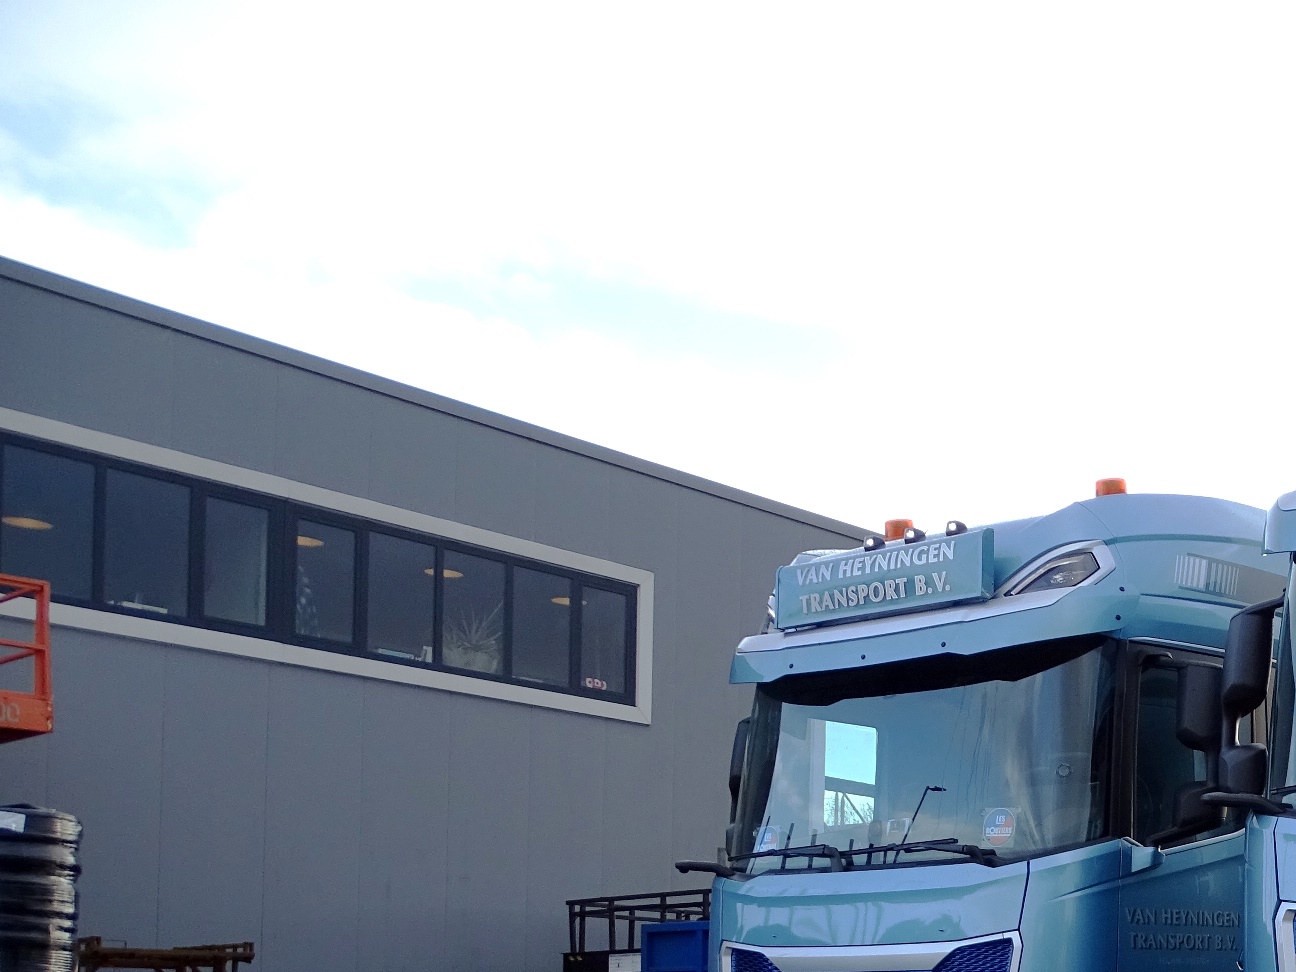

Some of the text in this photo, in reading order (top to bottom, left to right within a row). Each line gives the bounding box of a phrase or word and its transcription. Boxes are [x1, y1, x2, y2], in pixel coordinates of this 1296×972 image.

[796, 541, 956, 586] VAN HEYNINGEN
[800, 571, 951, 614] TRANSPORT B.V.
[1125, 907, 1241, 928] VAN HEYNINGEN
[1128, 931, 1238, 952] TRANSPORT B.V.
